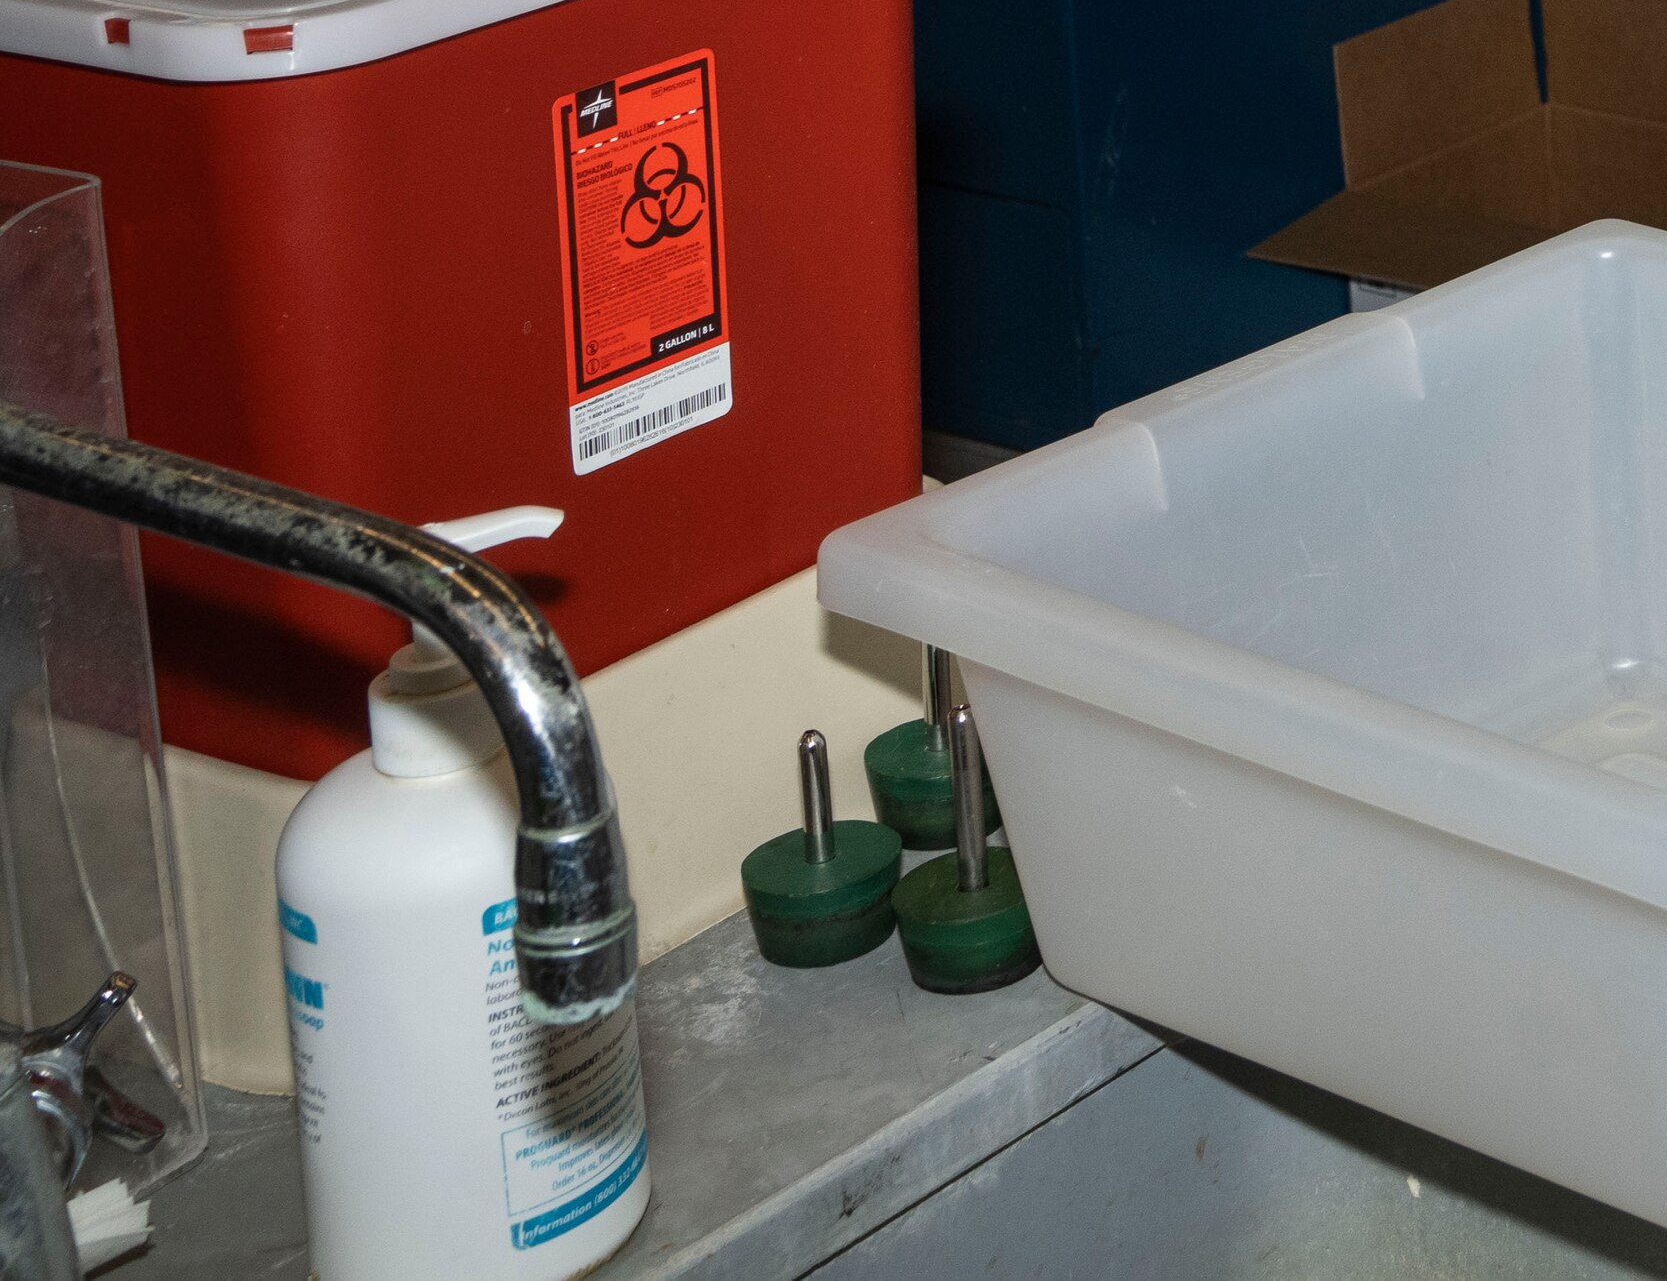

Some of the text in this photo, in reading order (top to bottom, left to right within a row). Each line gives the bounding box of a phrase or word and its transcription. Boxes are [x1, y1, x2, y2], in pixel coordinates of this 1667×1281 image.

[579, 99, 613, 118] MEDLINE
[618, 121, 657, 140] FULL LLENO
[576, 161, 613, 180] BIOHAZARD
[577, 176, 600, 189] RIESGO
[658, 323, 715, 353] 2 GALLON 8 L
[629, 374, 657, 389] Manufactured
[662, 367, 674, 377] China
[586, 405, 606, 418] Medline
[490, 1025, 501, 1037] of
[491, 1033, 525, 1051] for 60
[494, 1063, 519, 1078] with
[547, 1045, 563, 1058] Do
[564, 1038, 579, 1051] not
[494, 1078, 519, 1091] best
[496, 1085, 543, 1109] ACTIVE
[526, 1126, 541, 1139] For
[530, 1146, 571, 1170] Proguard
[558, 1147, 594, 1172] Improves
[551, 1175, 576, 1191] Order
[577, 1168, 588, 1179] 16
[518, 1181, 618, 1247] Information (800)
